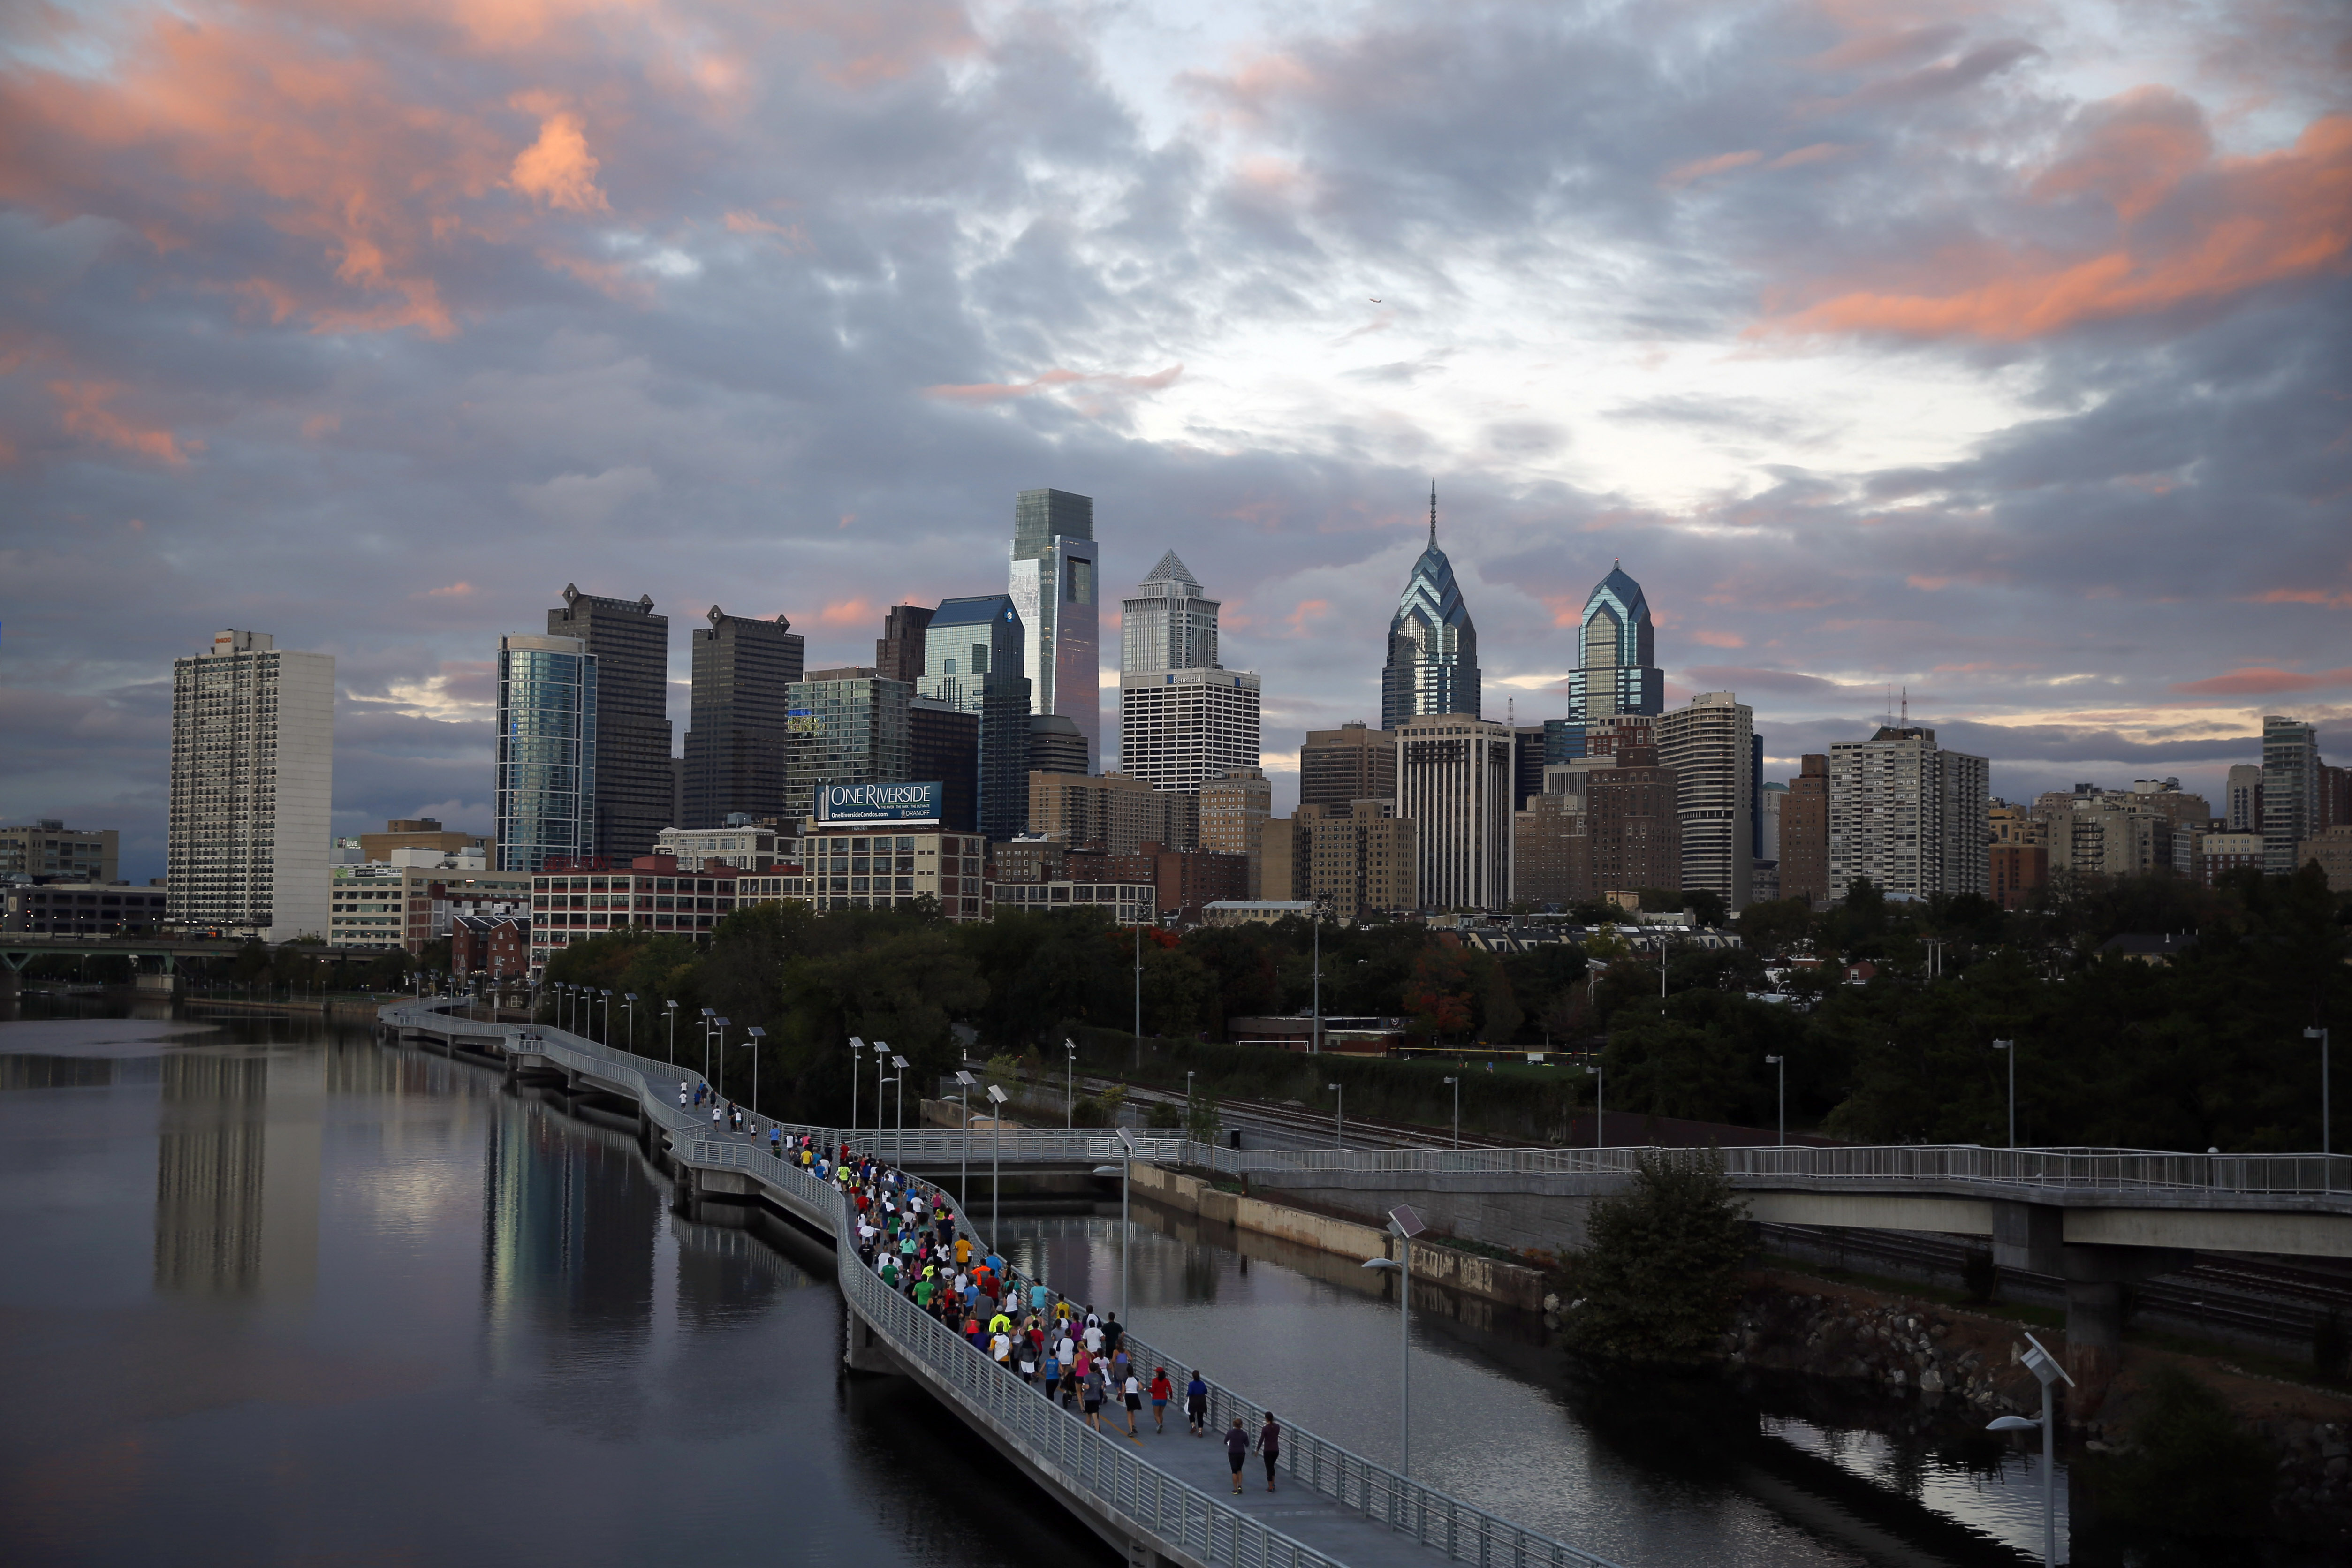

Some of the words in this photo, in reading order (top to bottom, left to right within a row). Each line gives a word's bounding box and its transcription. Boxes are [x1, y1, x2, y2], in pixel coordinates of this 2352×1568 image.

[1173, 675, 1200, 684] Beneficial
[831, 787, 864, 805] ONE
[866, 785, 931, 809] RIVERSIDE
